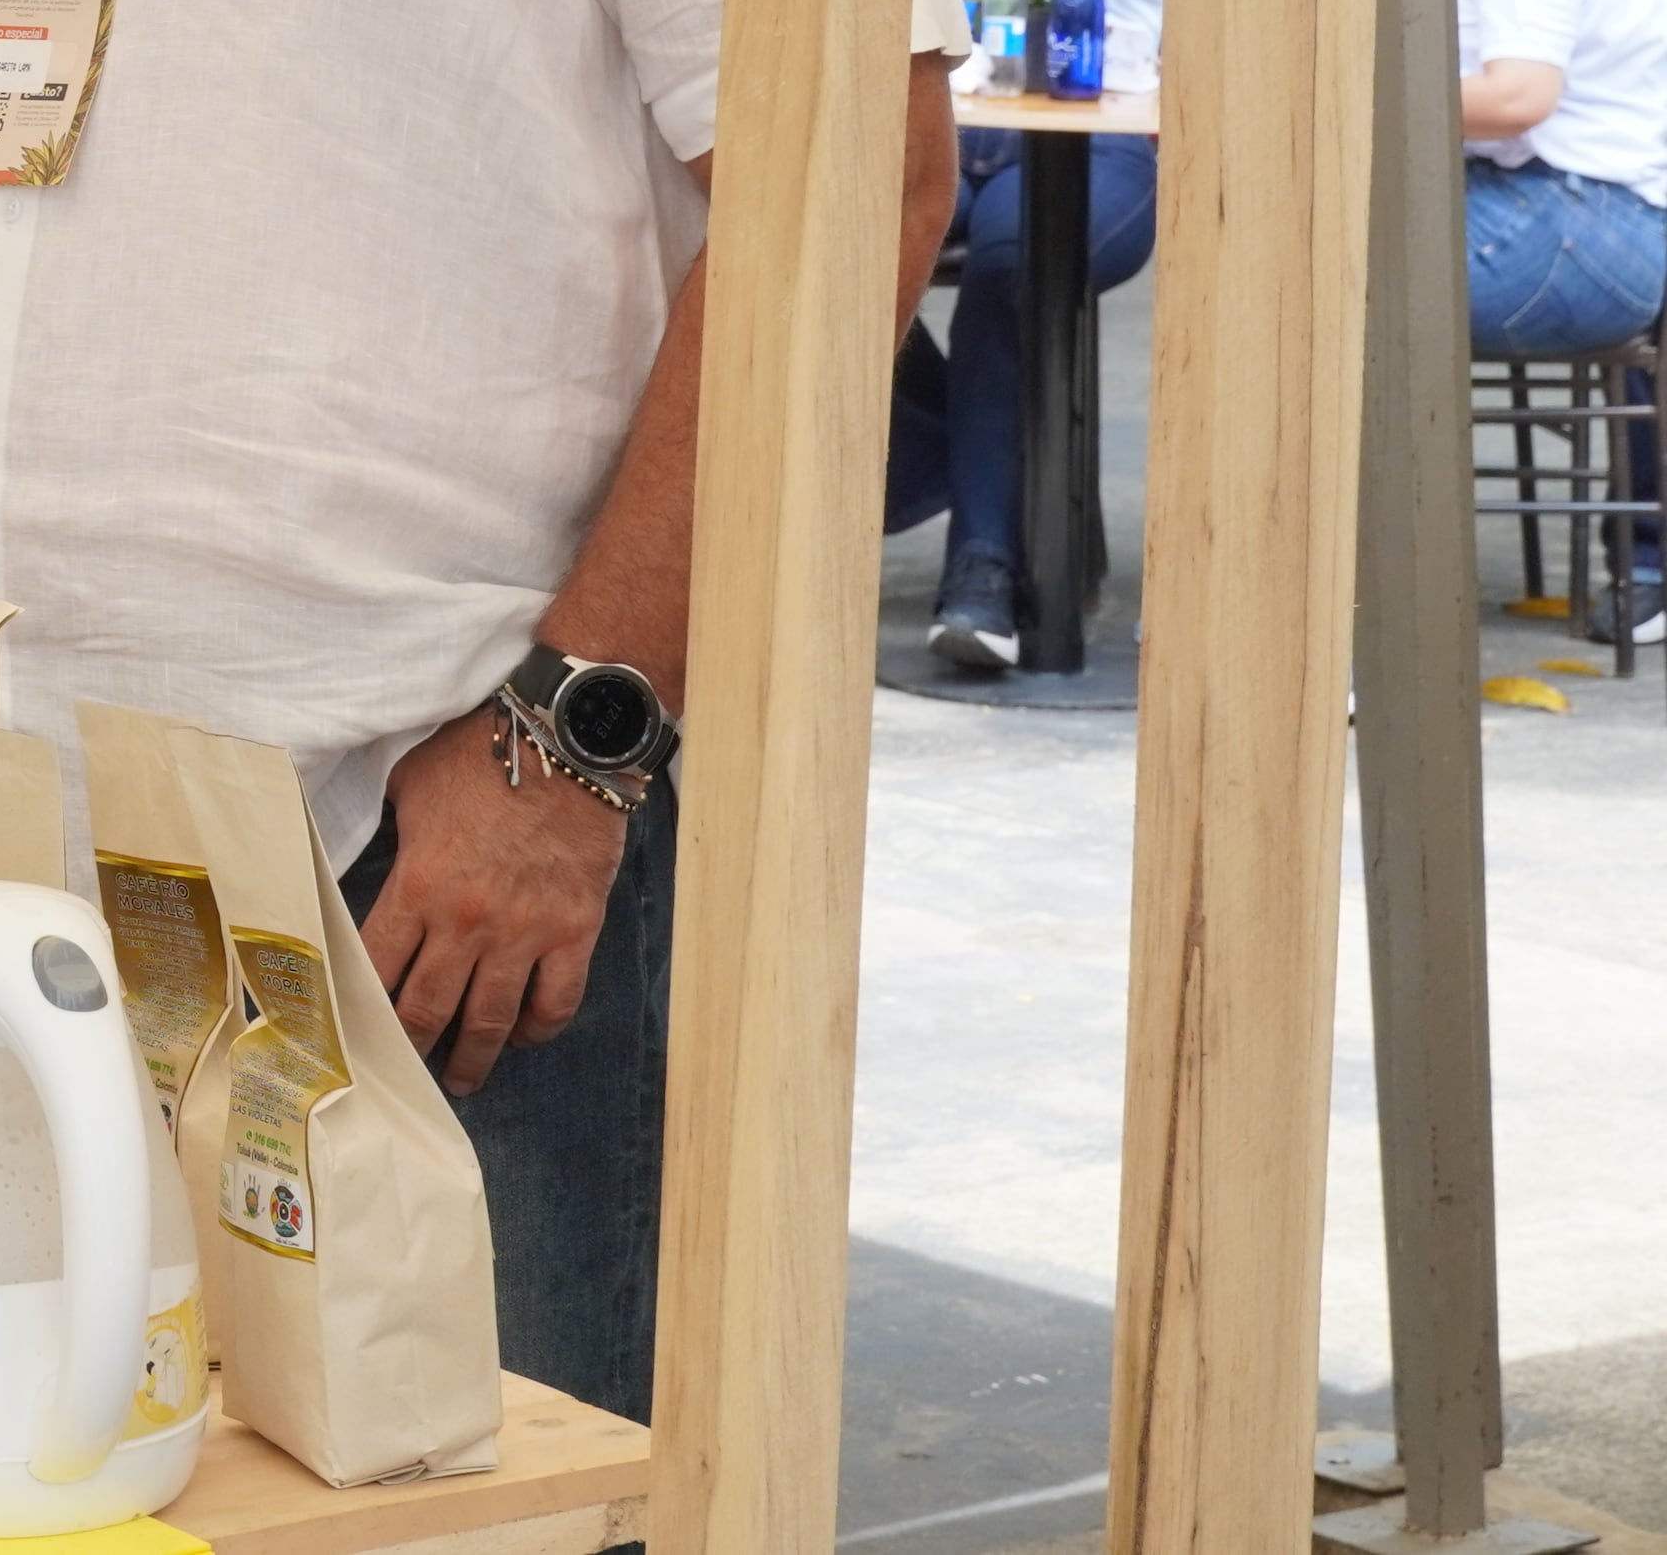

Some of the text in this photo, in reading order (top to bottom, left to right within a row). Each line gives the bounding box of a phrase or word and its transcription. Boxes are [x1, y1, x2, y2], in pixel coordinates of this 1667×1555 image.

[5, 28, 43, 40] especial
[115, 872, 190, 899] CAFÉ RÍO
[116, 893, 195, 922] MORALES
[257, 950, 299, 974] CAFÉ
[259, 972, 320, 1000] MORAL
[231, 1102, 283, 1128] LAS VIOLETAS
[273, 1156, 299, 1176] Colombia
